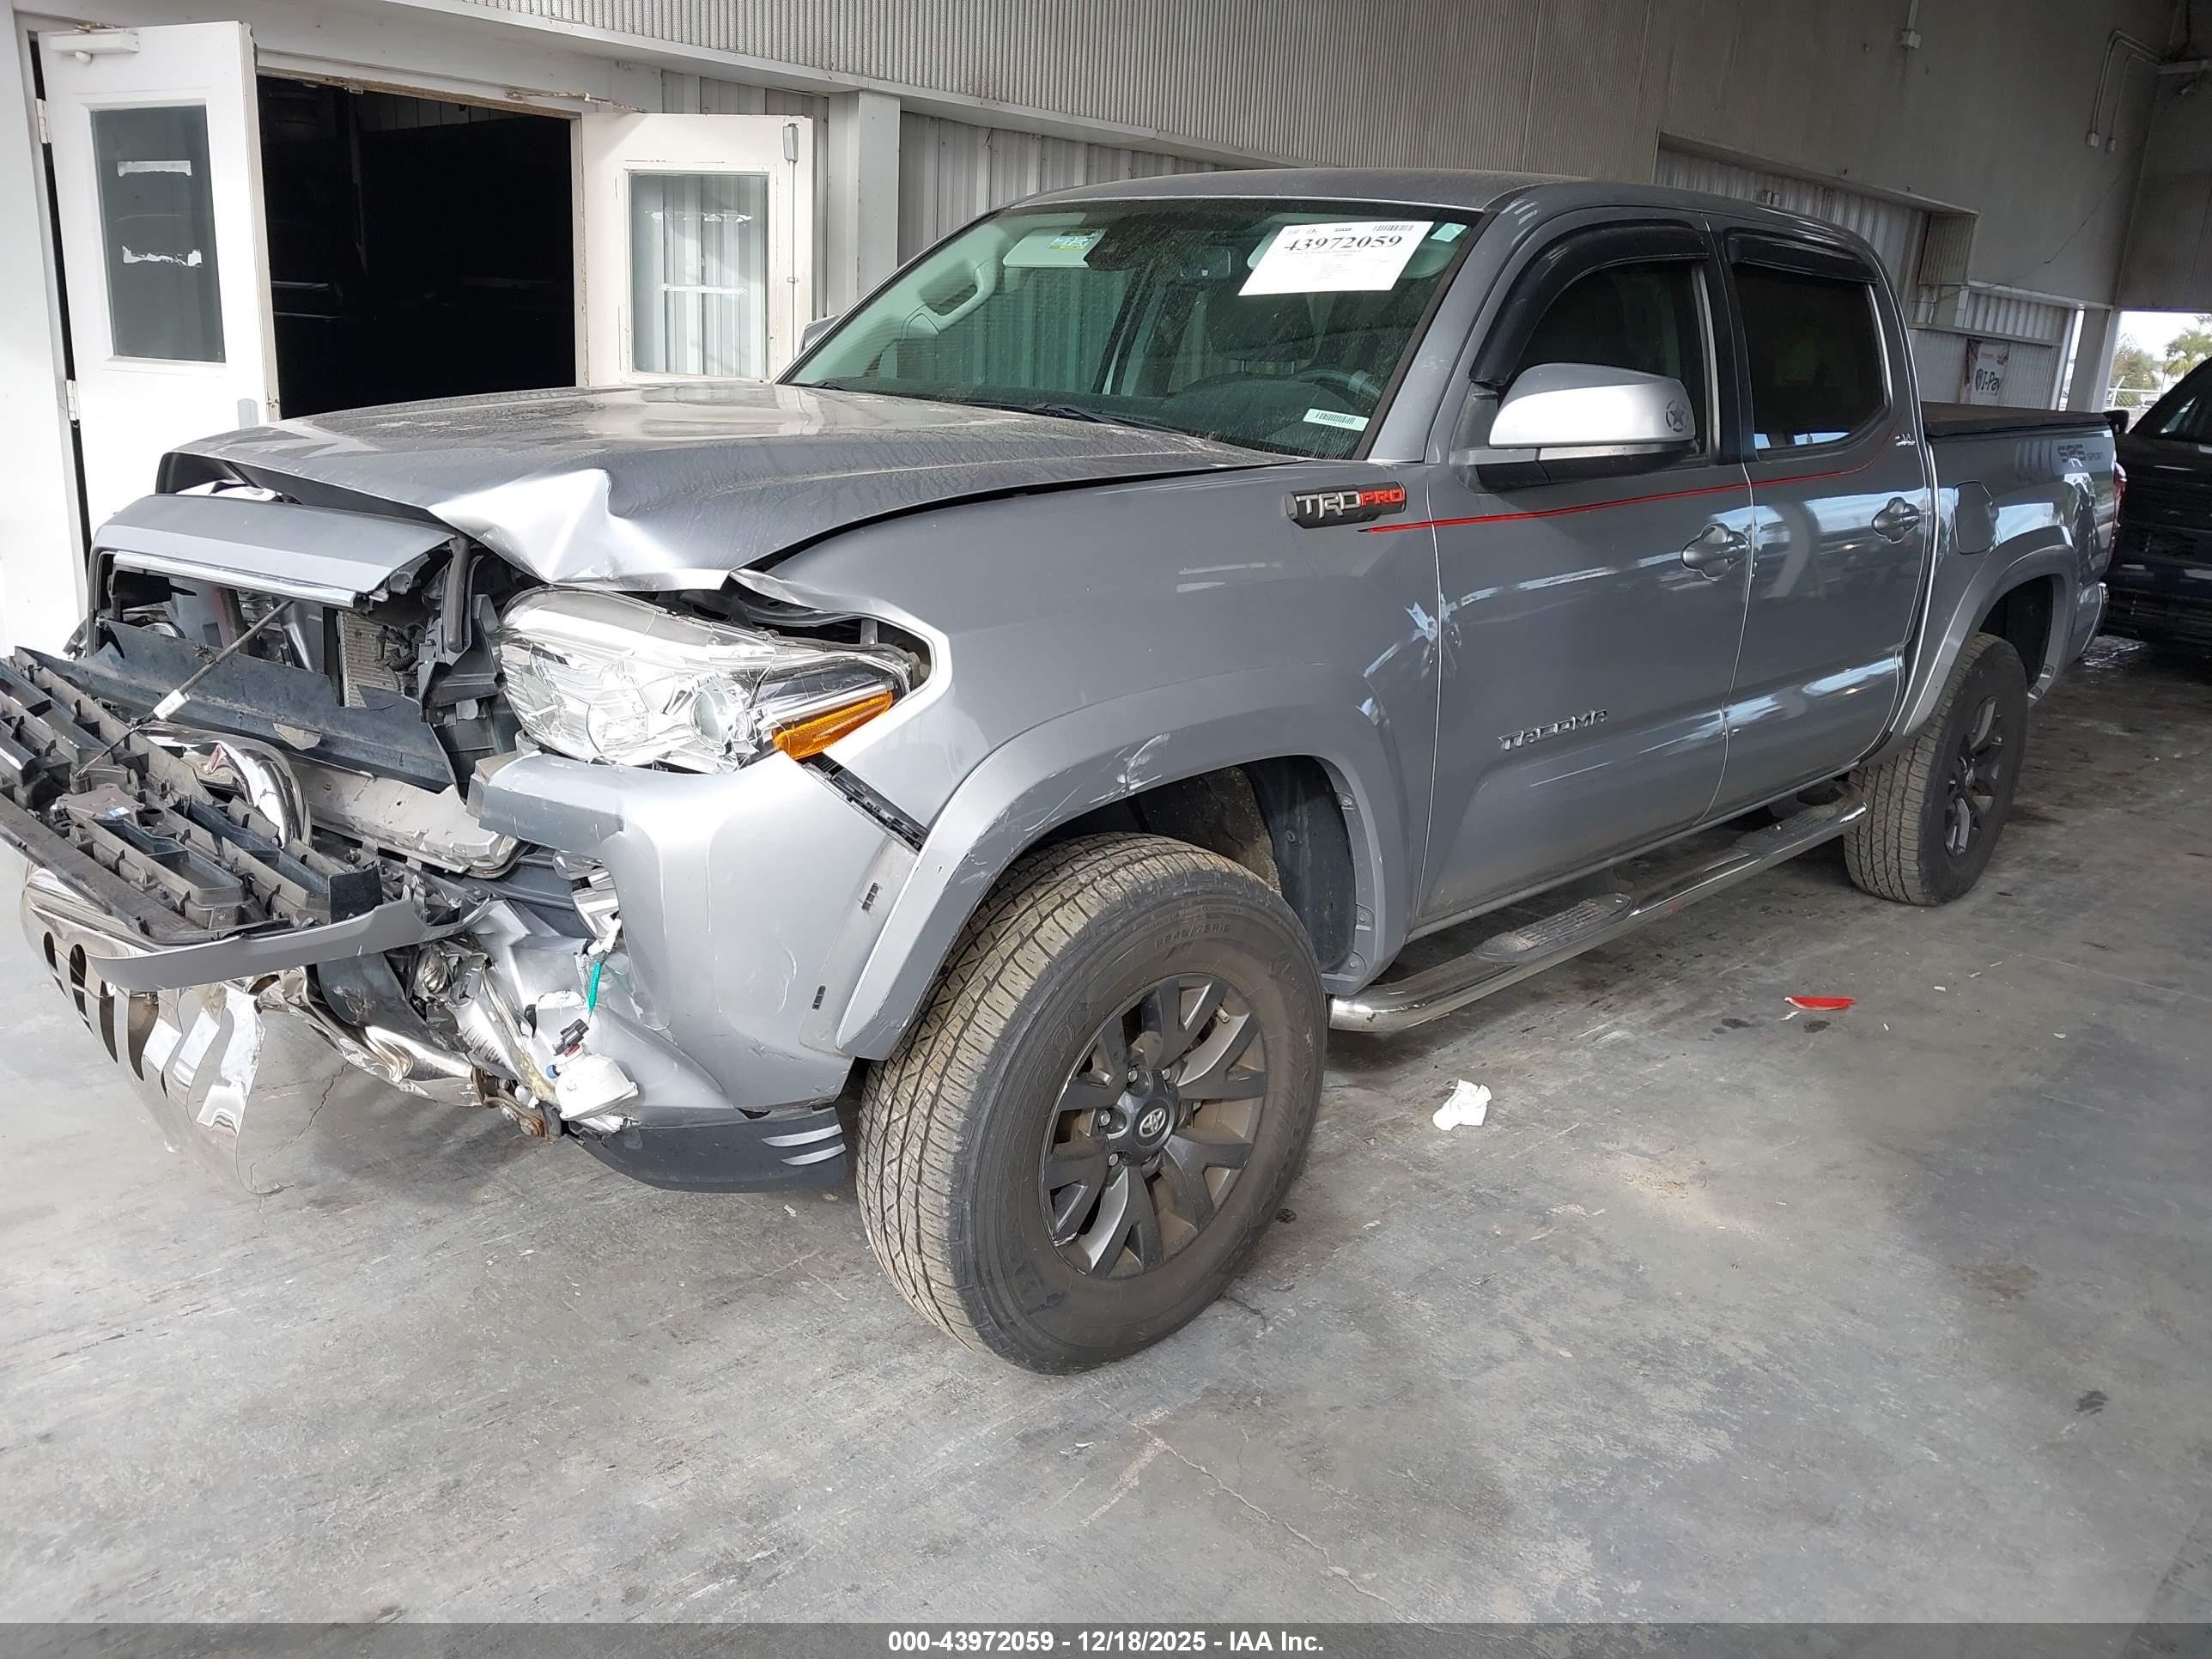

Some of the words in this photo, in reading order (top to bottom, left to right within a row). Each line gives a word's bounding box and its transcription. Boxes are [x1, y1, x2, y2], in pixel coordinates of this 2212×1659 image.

[1284, 235, 1403, 251] 43972059
[1296, 490, 1361, 519] TRD
[1360, 489, 1404, 507] PRO
[1497, 708, 1607, 750] TACOMA
